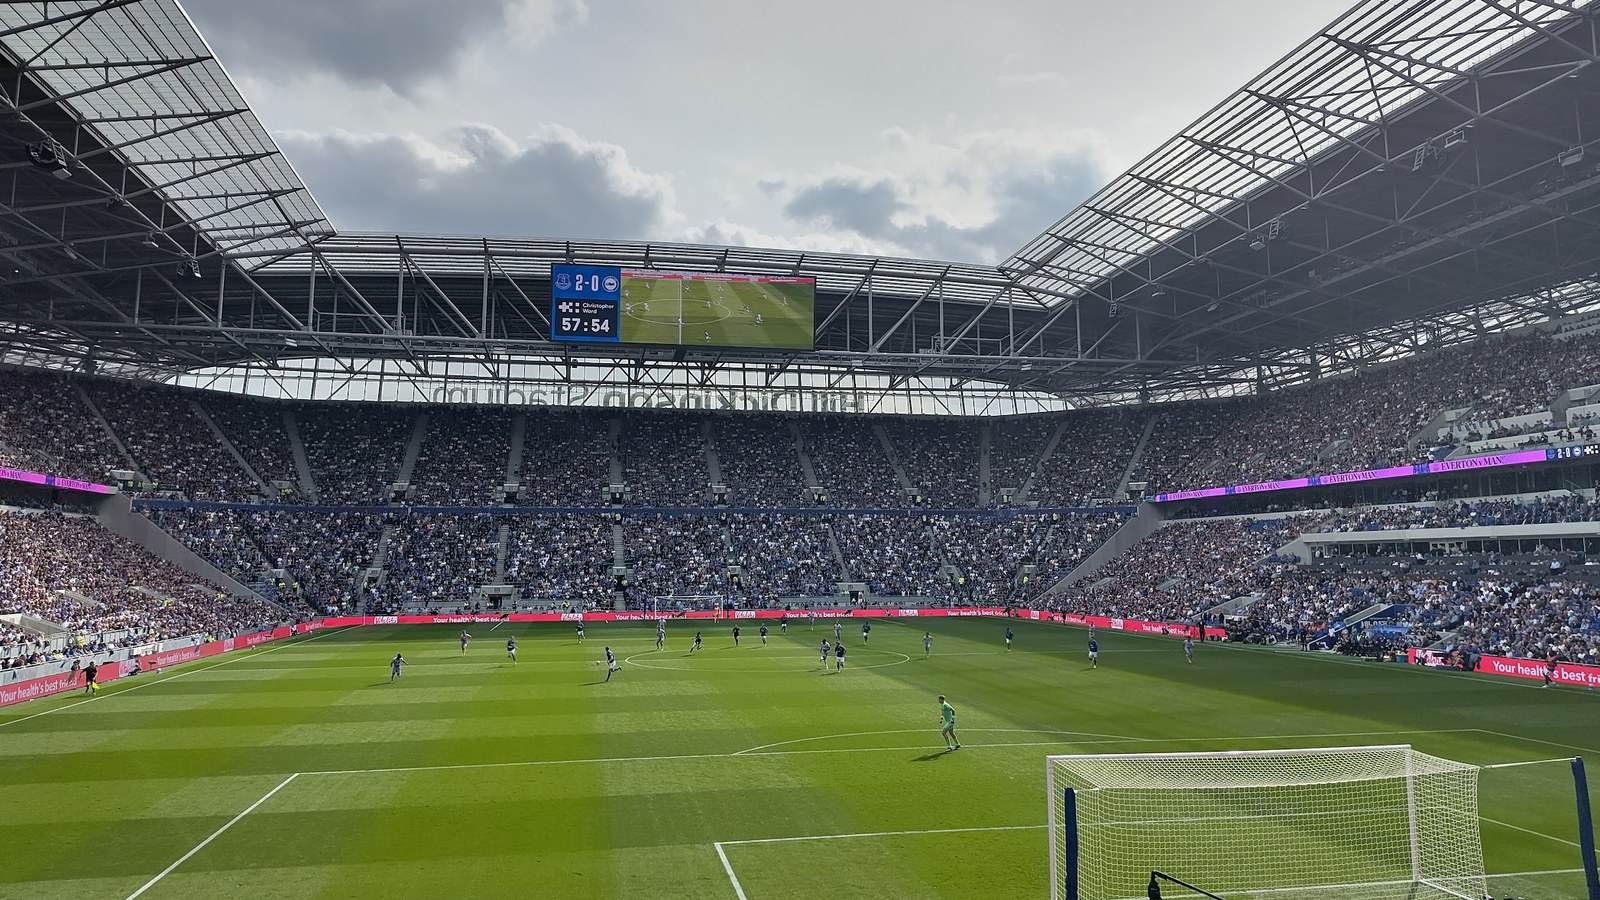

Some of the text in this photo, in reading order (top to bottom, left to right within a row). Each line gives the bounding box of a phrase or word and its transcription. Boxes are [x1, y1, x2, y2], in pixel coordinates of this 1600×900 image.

[582, 302, 614, 310] Christopher
[562, 317, 610, 333] 57:54
[1441, 458, 1478, 471] EVERTON
[1329, 473, 1358, 483] EVERTON
[1242, 485, 1264, 493] EVERTON
[156, 656, 167, 666] Your
[182, 651, 190, 660] best
[1492, 661, 1516, 673] Your
[1517, 663, 1559, 679] healts
[1561, 667, 1586, 682] best
[0, 690, 17, 703] Your
[17, 682, 44, 700] health's
[44, 680, 58, 692] best
